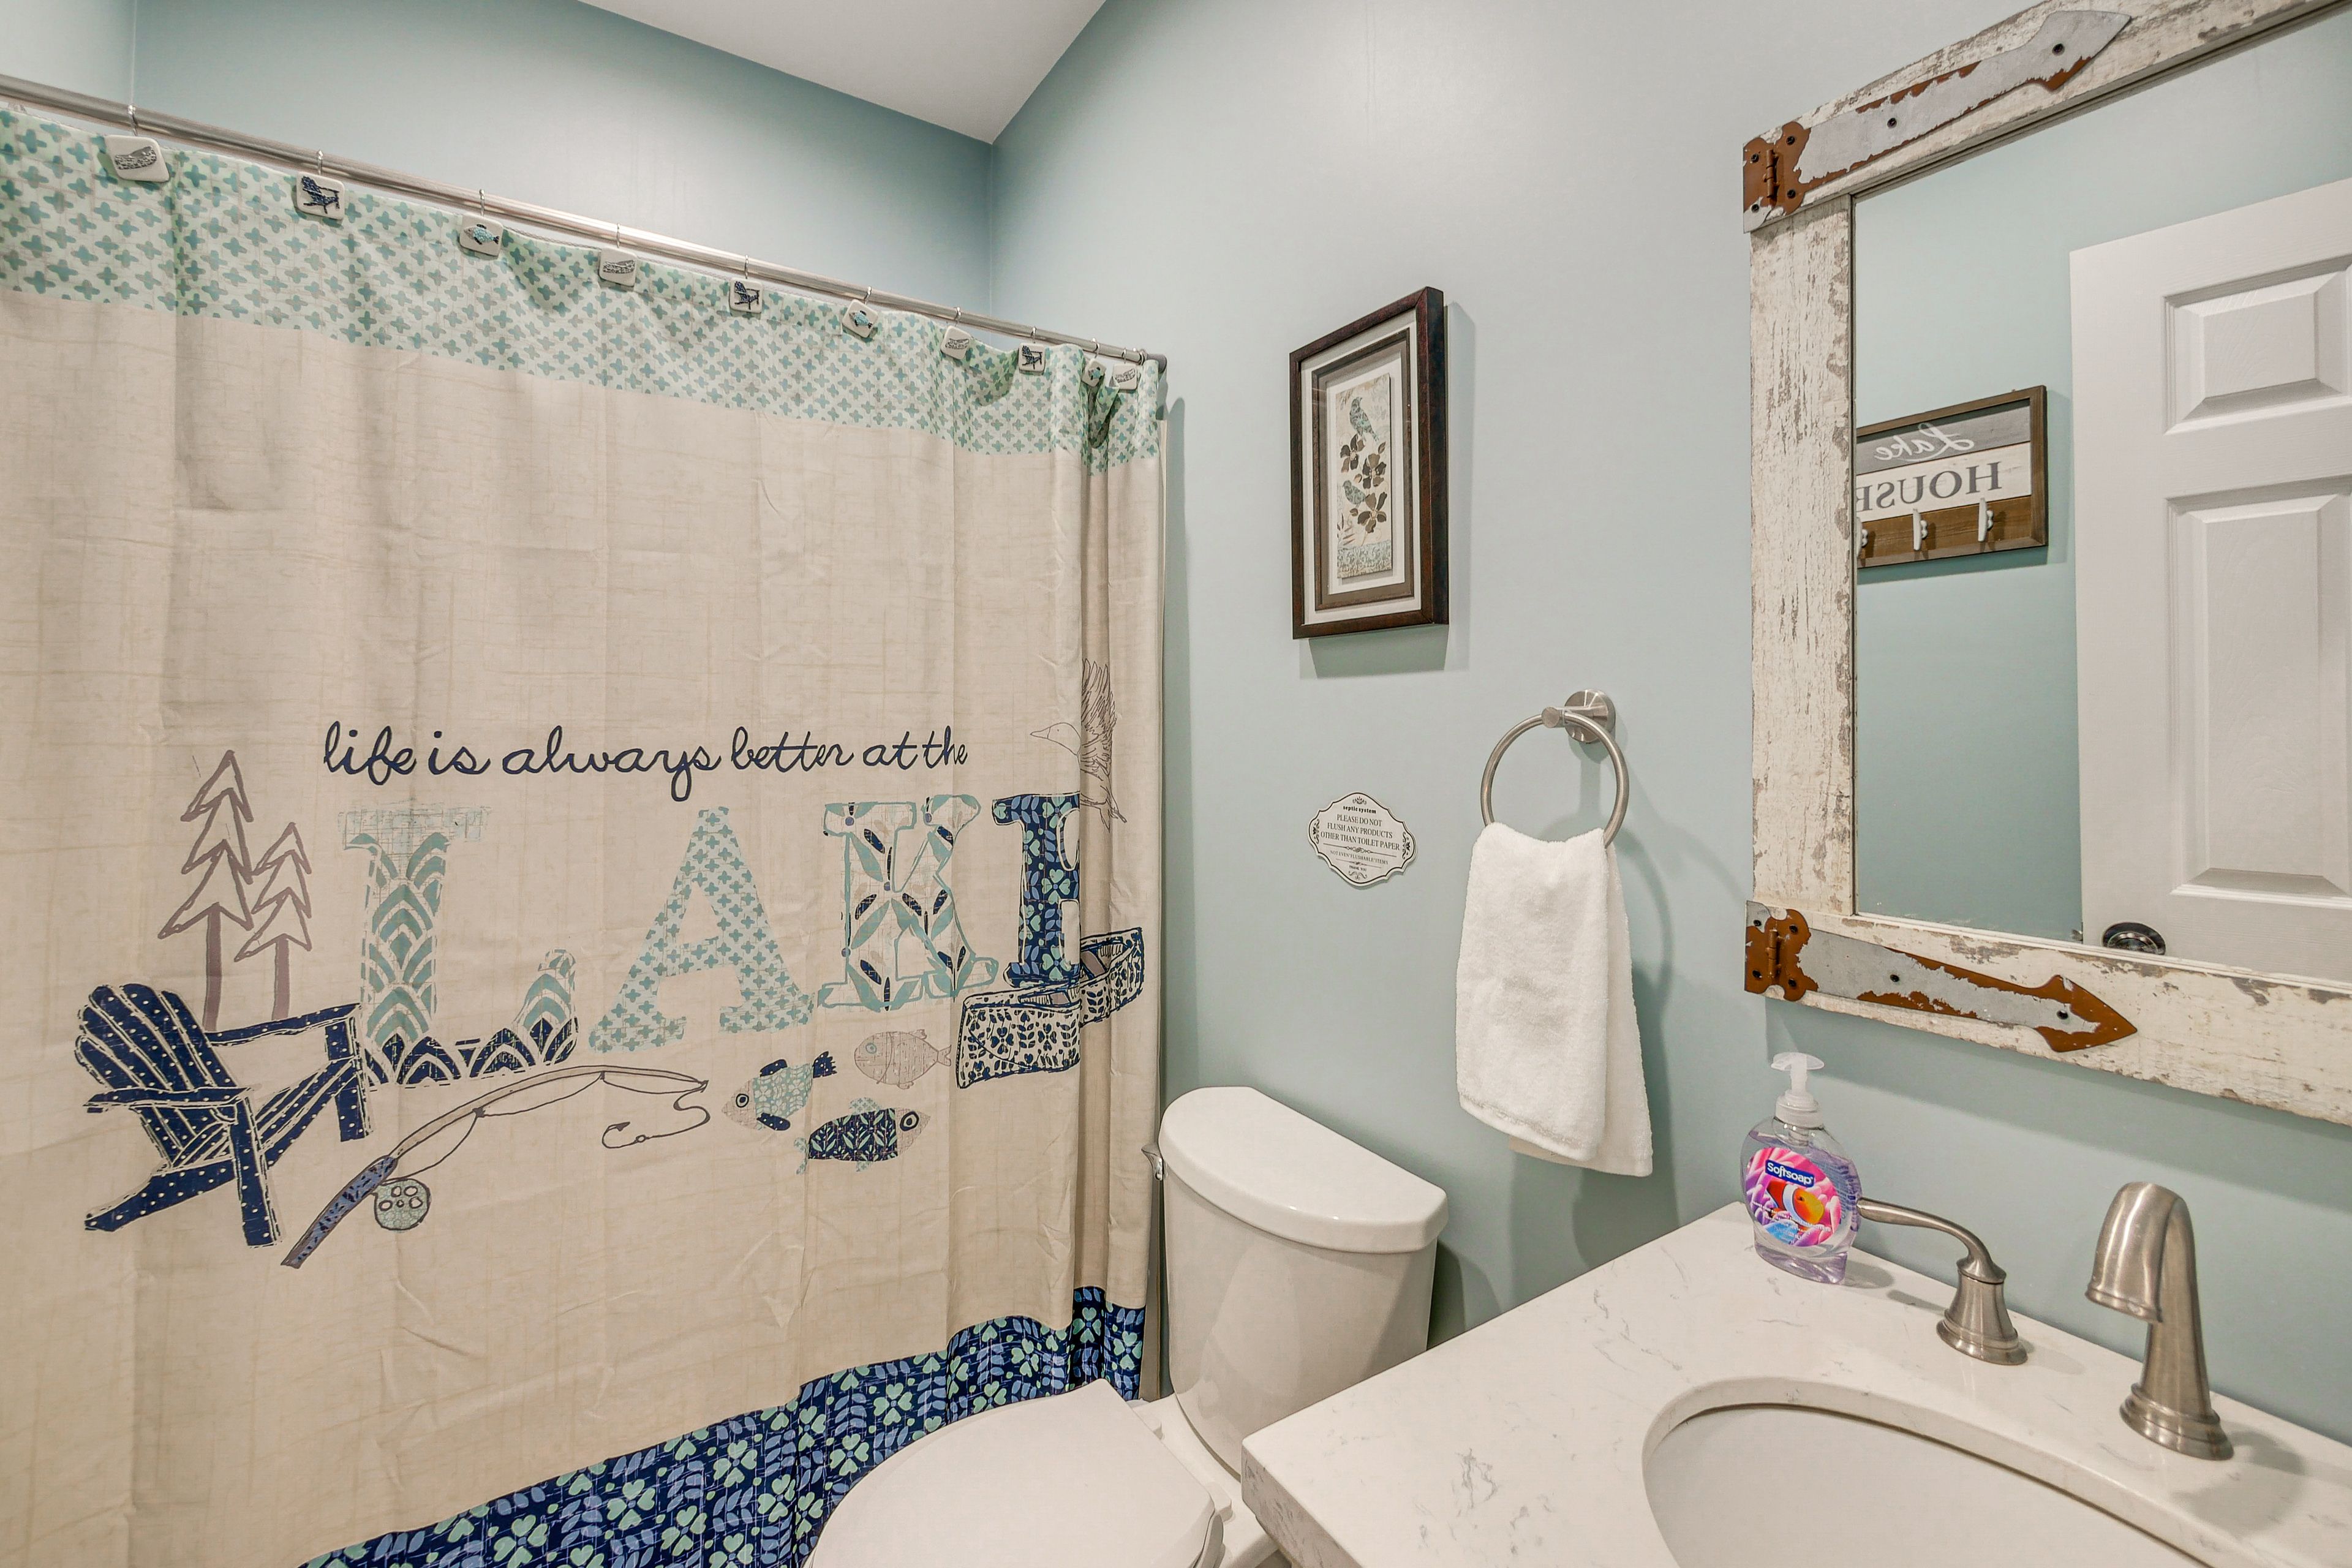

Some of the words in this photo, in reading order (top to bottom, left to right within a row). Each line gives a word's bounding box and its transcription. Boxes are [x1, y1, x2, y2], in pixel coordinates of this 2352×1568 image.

[323, 720, 417, 785] life
[428, 729, 491, 775] is
[502, 725, 722, 802] always
[731, 726, 854, 772] better
[862, 731, 918, 770] at
[922, 725, 968, 769] the
[1337, 813, 1359, 824] PLEASE
[1369, 818, 1382, 827] NOT
[1327, 822, 1346, 831] FLUSH
[1347, 825, 1359, 834] ANY
[1360, 827, 1393, 839] PRODUCTS
[1321, 831, 1339, 840] OTHER
[1340, 834, 1356, 843] THAN
[1357, 837, 1379, 846] TOILET
[1380, 840, 1400, 851] PAPER
[1767, 1162, 1812, 1185] Softsoap
